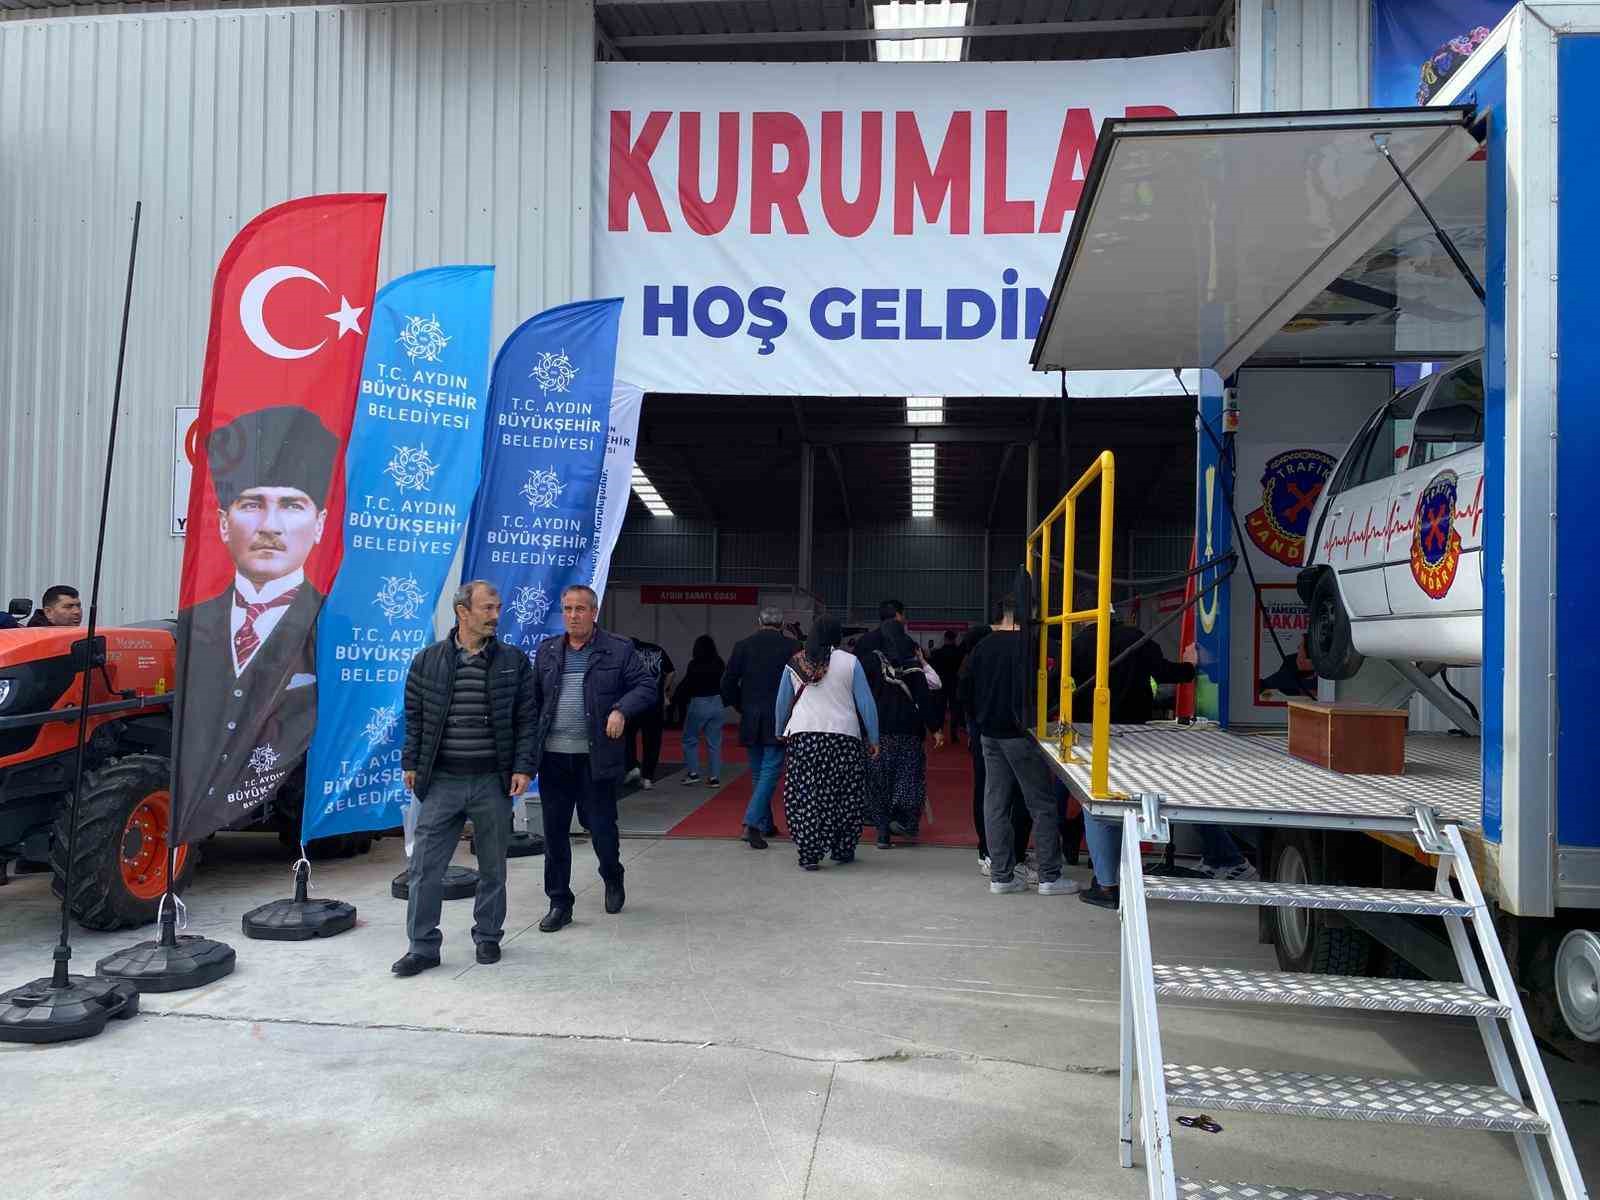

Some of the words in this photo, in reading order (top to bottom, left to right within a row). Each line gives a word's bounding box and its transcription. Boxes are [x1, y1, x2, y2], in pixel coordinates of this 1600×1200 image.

[642, 285, 788, 355] HOŞ
[377, 363, 407, 381] T.C.
[412, 370, 467, 389] AYDIN
[362, 379, 477, 410] BÜYÜKŞEHİR
[368, 402, 470, 430] BELEDİYESİ
[511, 397, 540, 412] T.C.
[544, 400, 592, 415] AYDIN
[498, 411, 601, 434] BÜYÜKŞEHİR
[502, 432, 594, 452] BELEDİYESİ
[364, 494, 395, 511] T.C.
[401, 499, 456, 517] AYDIN
[501, 515, 529, 528] T.C.
[532, 517, 581, 532] AYDIN
[487, 530, 588, 550] BÜYÜKŞEHİR
[1250, 517, 1300, 559] JAND
[491, 550, 580, 567] BELEDİYESİ
[352, 627, 383, 643] T.C.
[341, 666, 409, 682] BELEDİ
[368, 748, 402, 769] AYD
